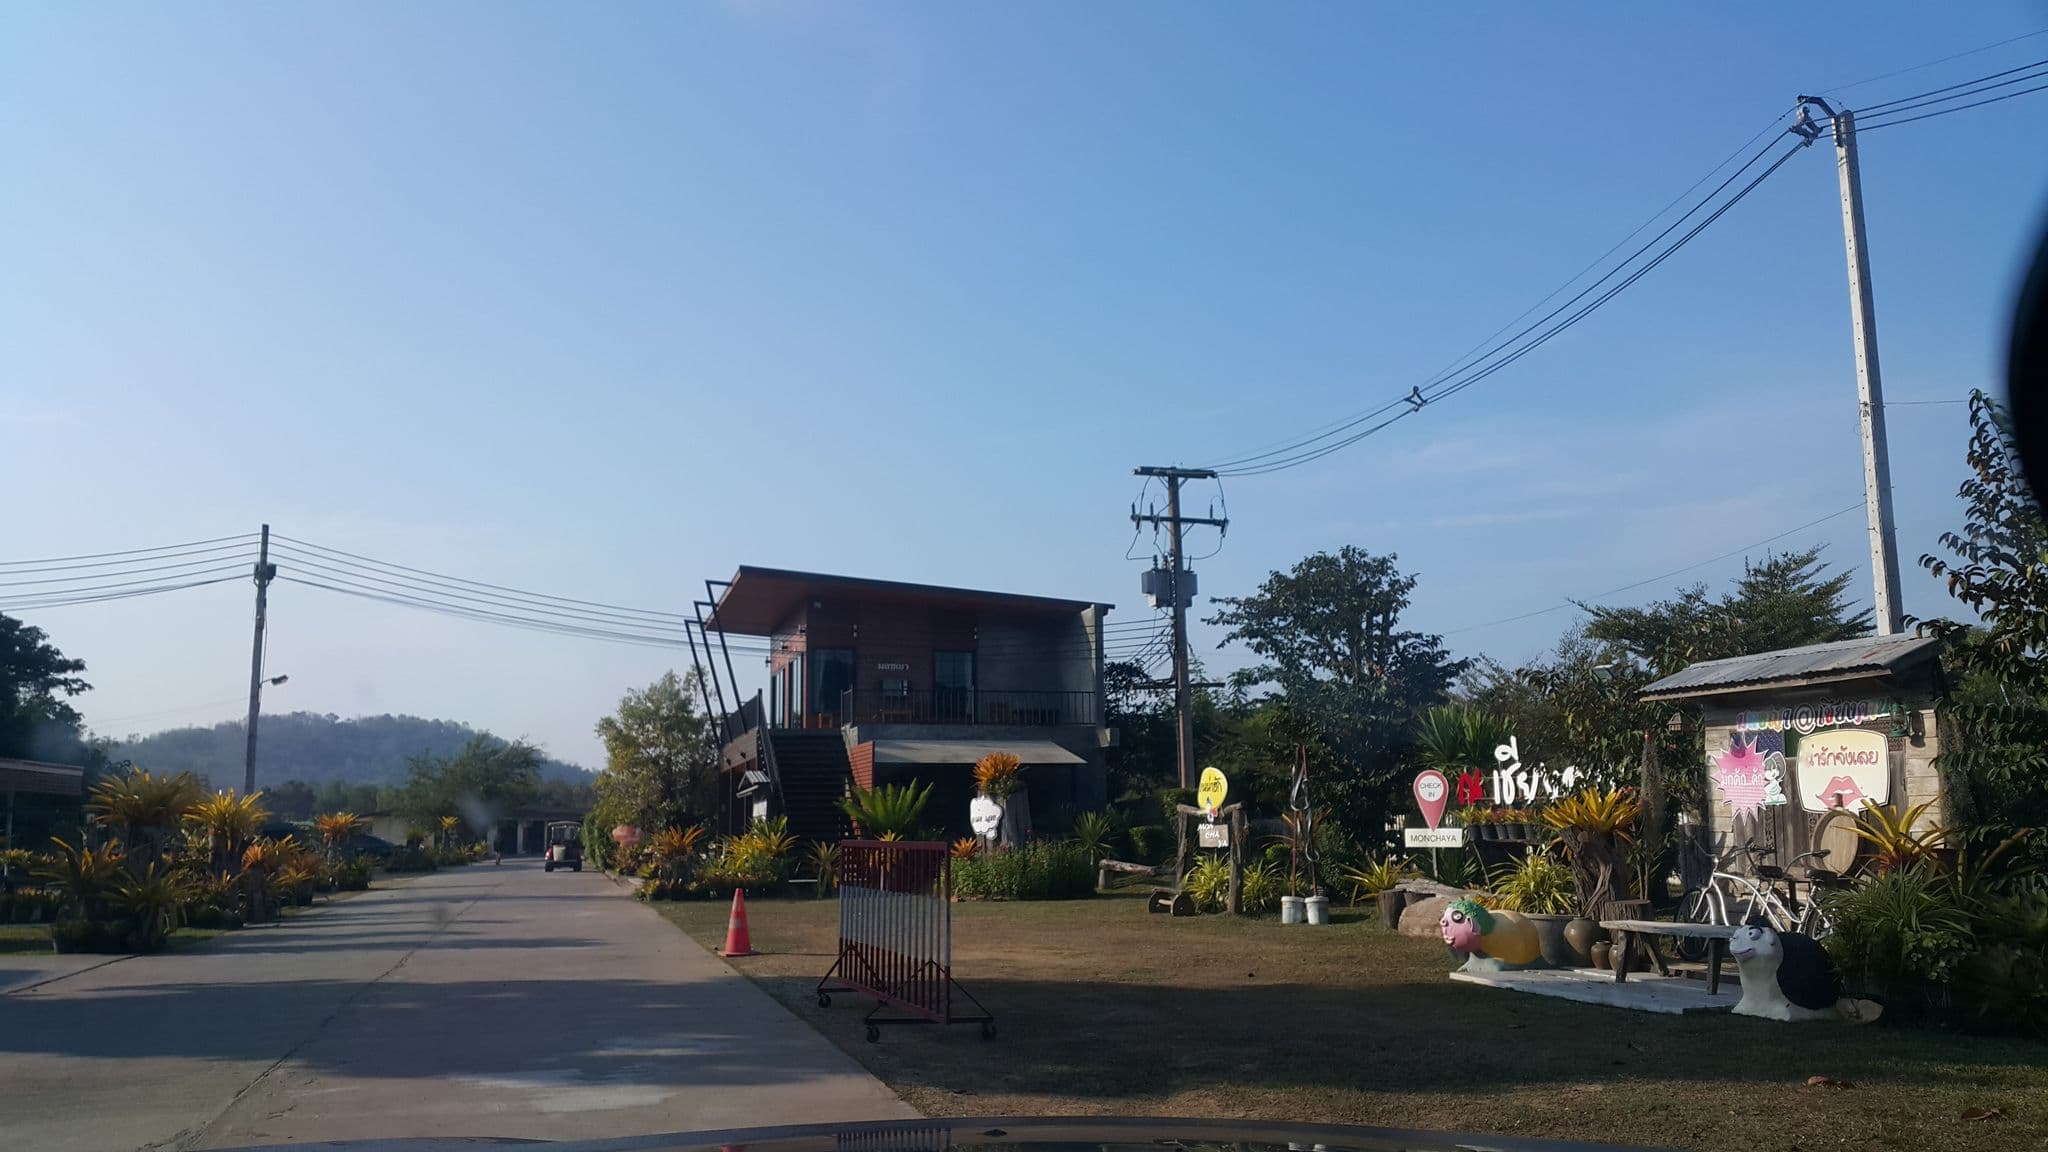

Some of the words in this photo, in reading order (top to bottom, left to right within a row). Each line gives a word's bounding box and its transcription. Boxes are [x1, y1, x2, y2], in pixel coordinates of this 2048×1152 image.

[1197, 823, 1214, 831] MON
[1410, 835, 1457, 843] MONCHAYA
[1217, 839, 1229, 848] YA
